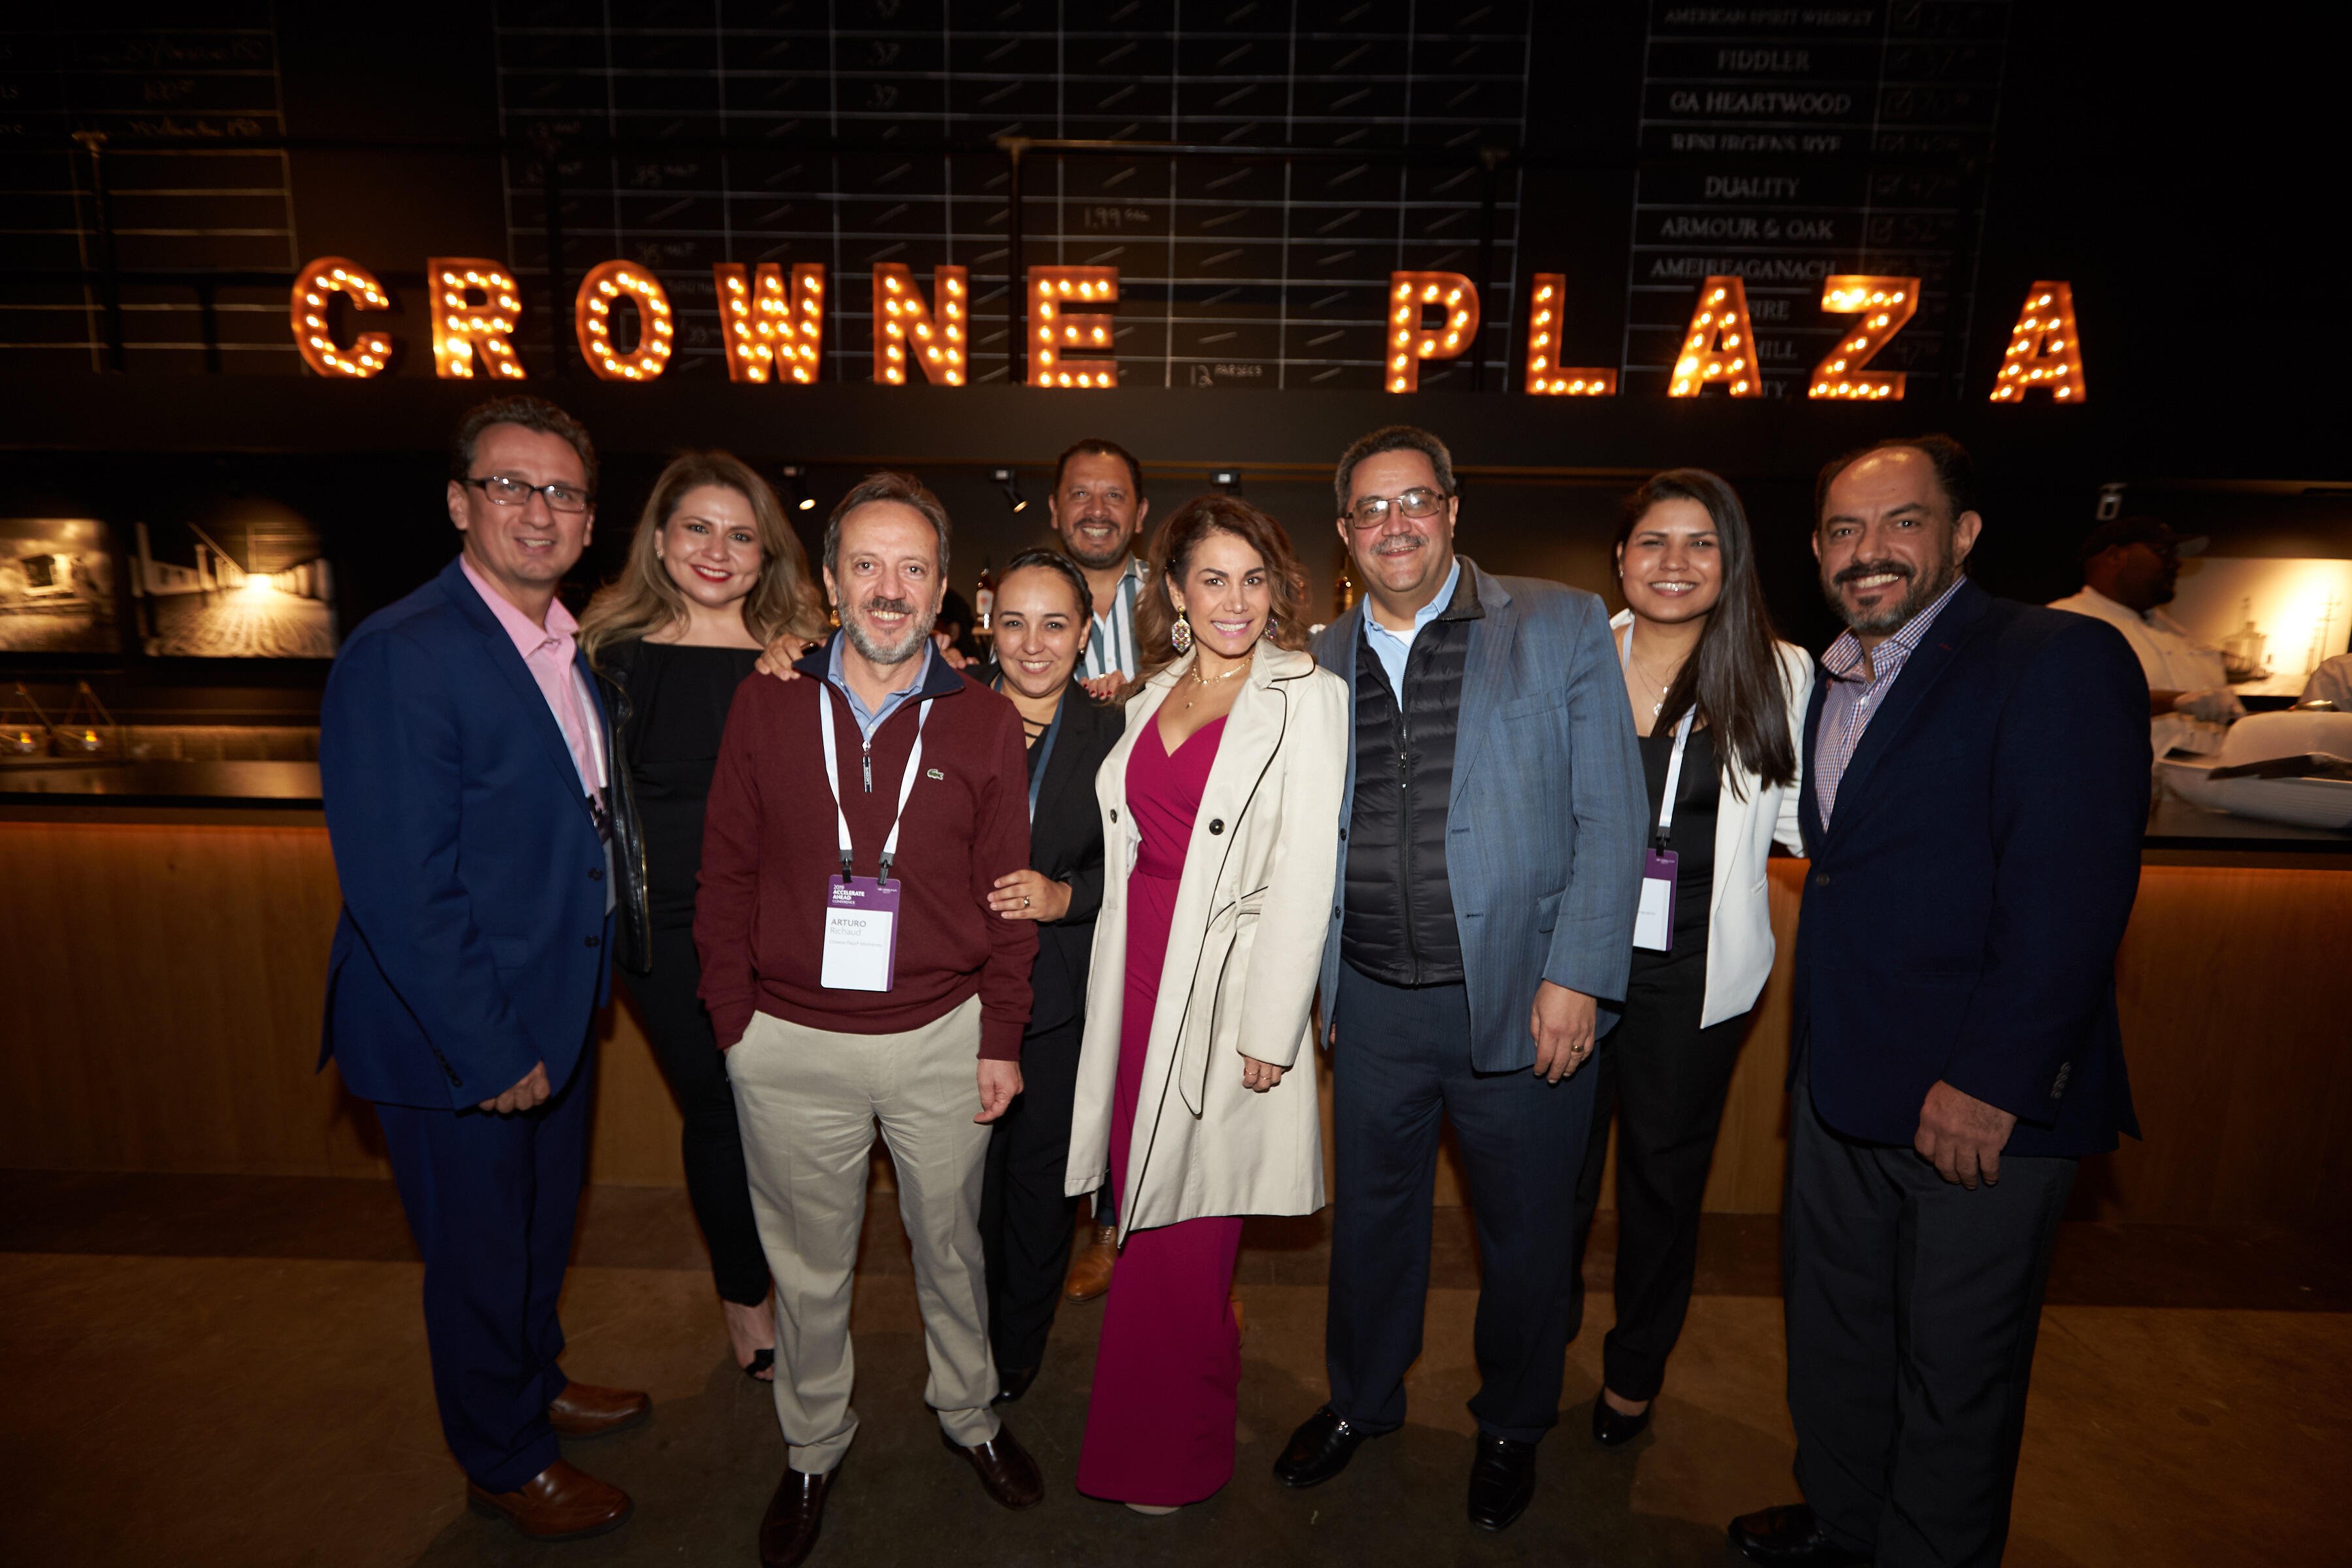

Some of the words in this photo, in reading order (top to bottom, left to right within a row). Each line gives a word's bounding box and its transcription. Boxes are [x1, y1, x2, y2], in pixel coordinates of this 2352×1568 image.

[1717, 48, 1810, 72] FIDDLER
[1669, 90, 1700, 113] GA
[1705, 91, 1852, 115] HEARTWOOD
[1704, 176, 1800, 198] DUALITY
[1085, 206, 1122, 229] 1.99
[1659, 216, 1761, 239] ARMOUR
[1764, 218, 1780, 238] &
[1786, 218, 1835, 240] OAK
[291, 257, 1119, 388] CROWNE
[1384, 270, 2087, 404] PLAZA
[1190, 365, 1213, 388] 12
[830, 919, 867, 928] ARTURO
[830, 926, 862, 936] Richaud
